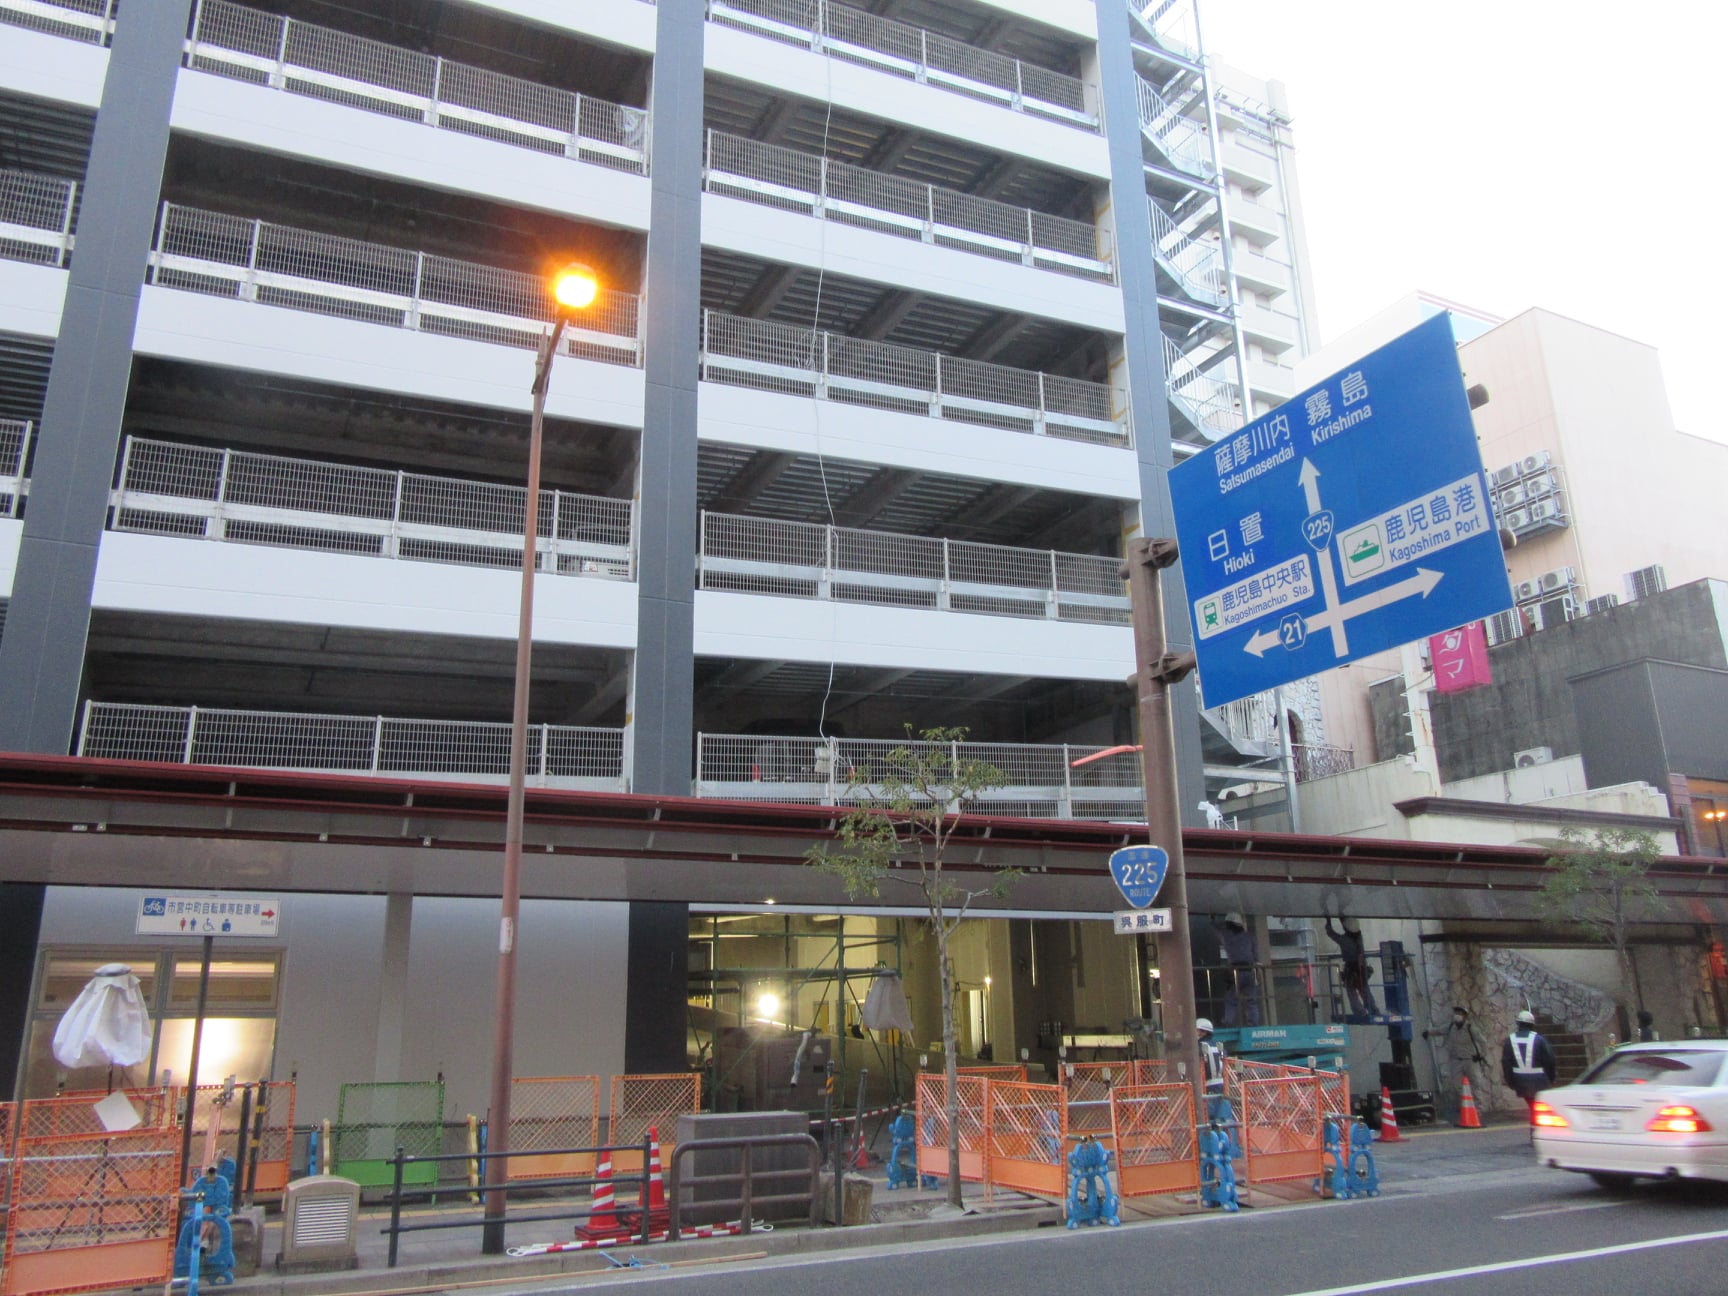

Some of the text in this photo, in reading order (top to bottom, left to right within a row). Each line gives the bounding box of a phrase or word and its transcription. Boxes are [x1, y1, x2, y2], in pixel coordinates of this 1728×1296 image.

[1305, 370, 1368, 426] 霧島
[1214, 414, 1290, 477] 薩摩川内
[1311, 404, 1372, 446] Kirishima
[1219, 442, 1295, 494] Satsumasendai
[1307, 516, 1331, 541] 225
[1385, 483, 1476, 544] 鹿児島港
[1208, 511, 1264, 561] 日置
[1389, 514, 1481, 563] Kagoshima Port
[1223, 548, 1255, 575] Hioki
[1221, 559, 1308, 612] 鹿児島中央駅
[1224, 584, 1310, 625] Kagoshimachuo Sta.
[1283, 619, 1303, 644] 21
[1121, 861, 1158, 887] 225
[1130, 887, 1151, 897] ROUTE
[1121, 914, 1164, 928] 呉服町
